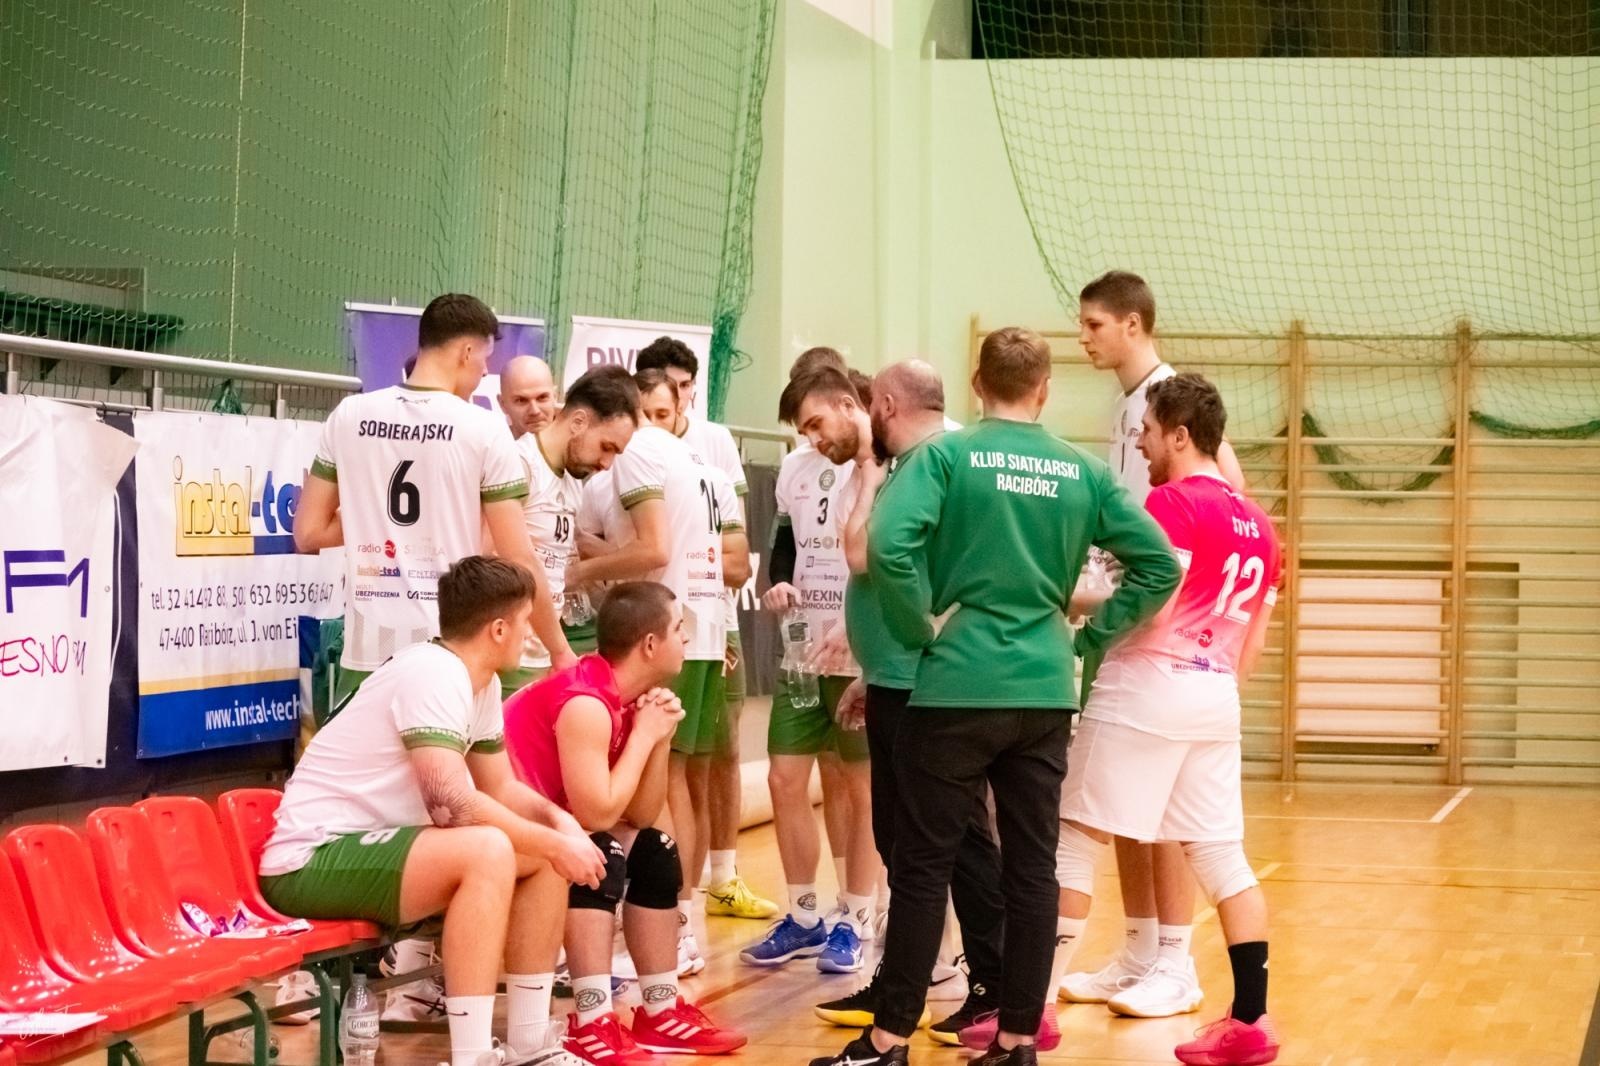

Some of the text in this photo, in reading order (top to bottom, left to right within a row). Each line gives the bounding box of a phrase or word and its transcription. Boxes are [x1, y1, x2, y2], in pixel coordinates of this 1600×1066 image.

[358, 420, 454, 444] SOBIERAJSKI
[970, 451, 1080, 480] KLUB SIATKARSKI
[387, 460, 420, 527] 6
[996, 473, 1059, 498] RACIBÓRZ
[817, 497, 829, 526] 3
[554, 515, 570, 543] 49
[249, 583, 272, 606] 632
[1210, 552, 1265, 625] 12
[263, 624, 283, 642] von
